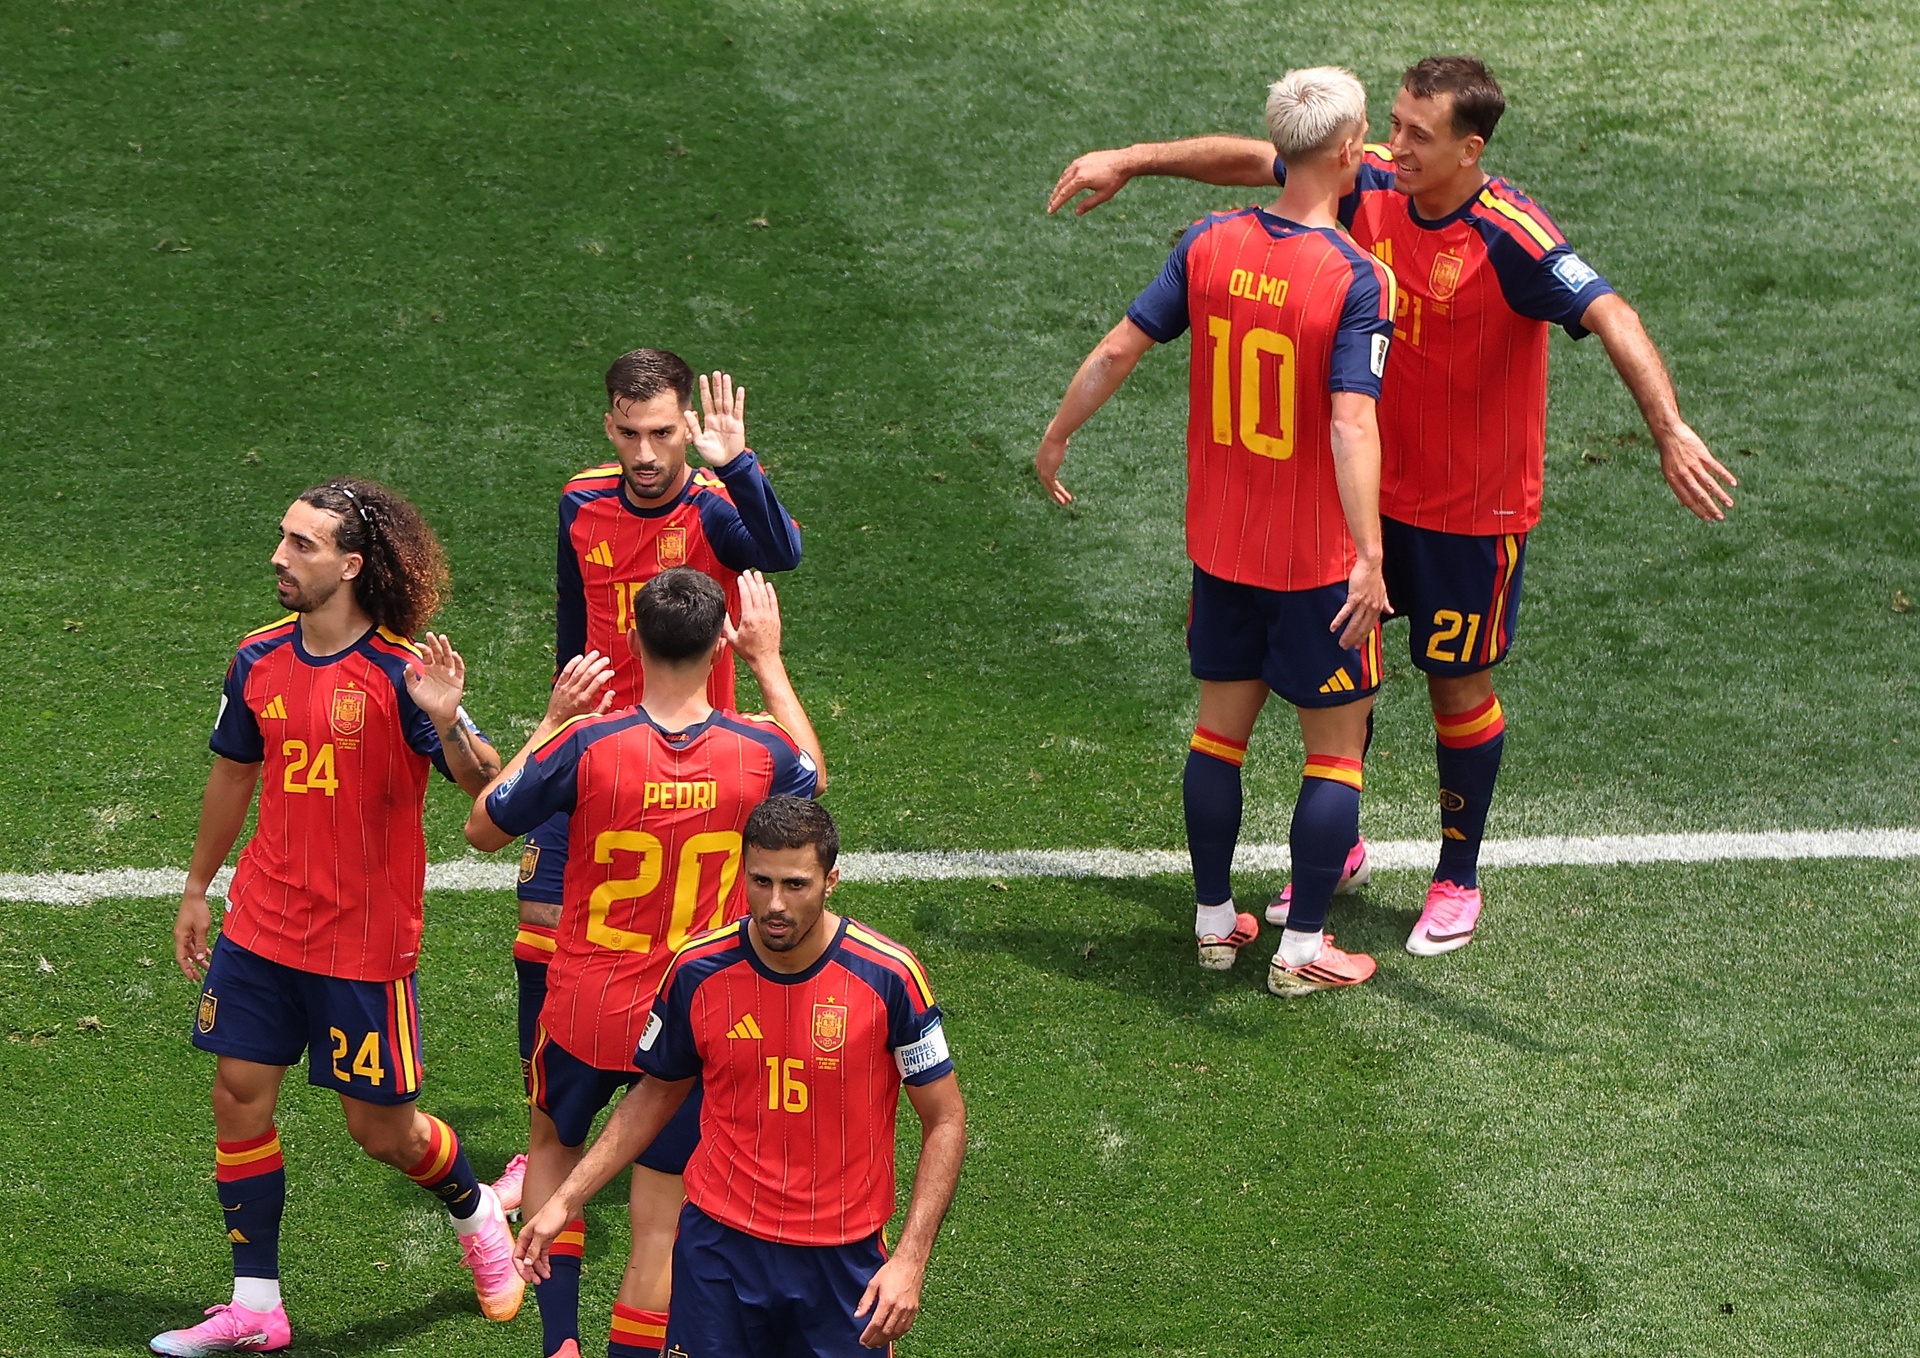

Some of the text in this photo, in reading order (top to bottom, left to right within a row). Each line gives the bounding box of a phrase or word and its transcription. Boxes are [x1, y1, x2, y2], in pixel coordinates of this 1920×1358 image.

[1229, 267, 1289, 308] OLMO
[1208, 316, 1295, 460] 10
[1426, 609, 1481, 662] 21
[283, 739, 339, 797] 24
[643, 781, 717, 810] PEDRI
[586, 830, 744, 955] 20
[330, 1027, 385, 1086] 24
[901, 1040, 934, 1058] FOOTBALL
[903, 1047, 937, 1067] UNITES
[765, 1056, 808, 1113] 16
